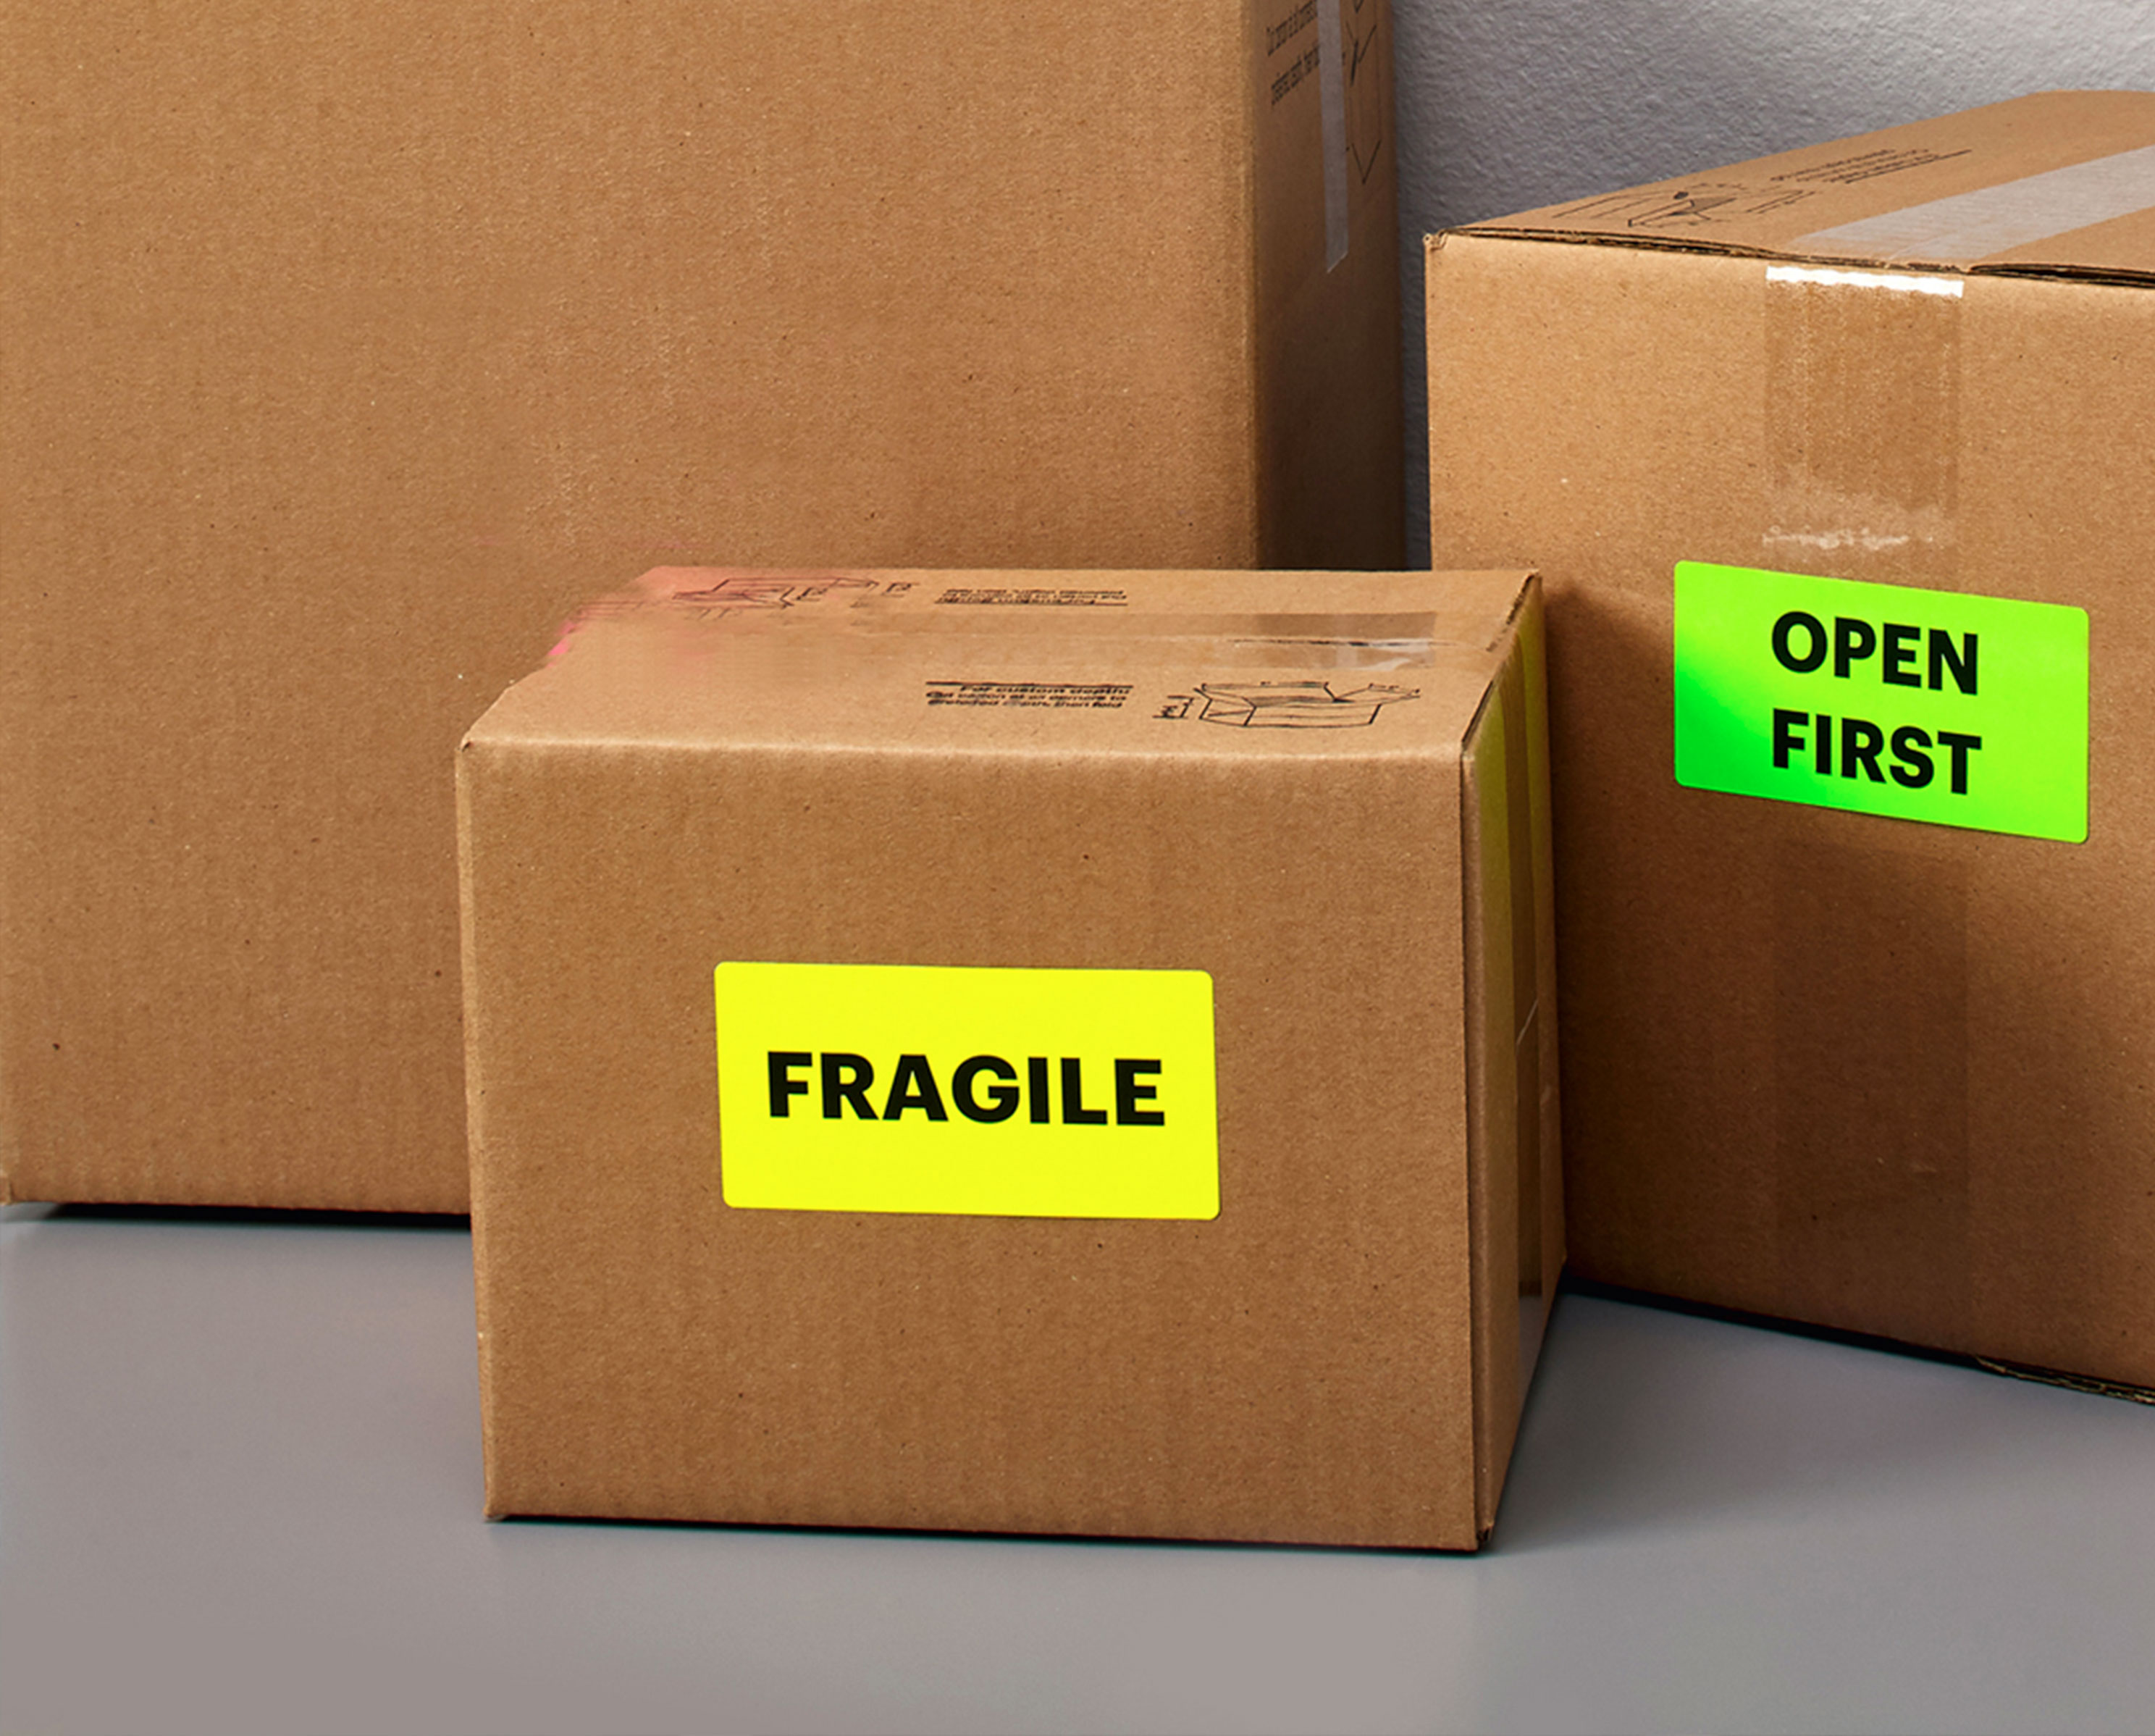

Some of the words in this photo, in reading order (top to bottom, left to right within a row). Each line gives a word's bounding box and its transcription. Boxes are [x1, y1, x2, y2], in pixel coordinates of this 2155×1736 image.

[1772, 611, 1978, 695] OPEN
[1773, 708, 1982, 795] FIRST
[768, 1051, 1165, 1126] FRAGILE
